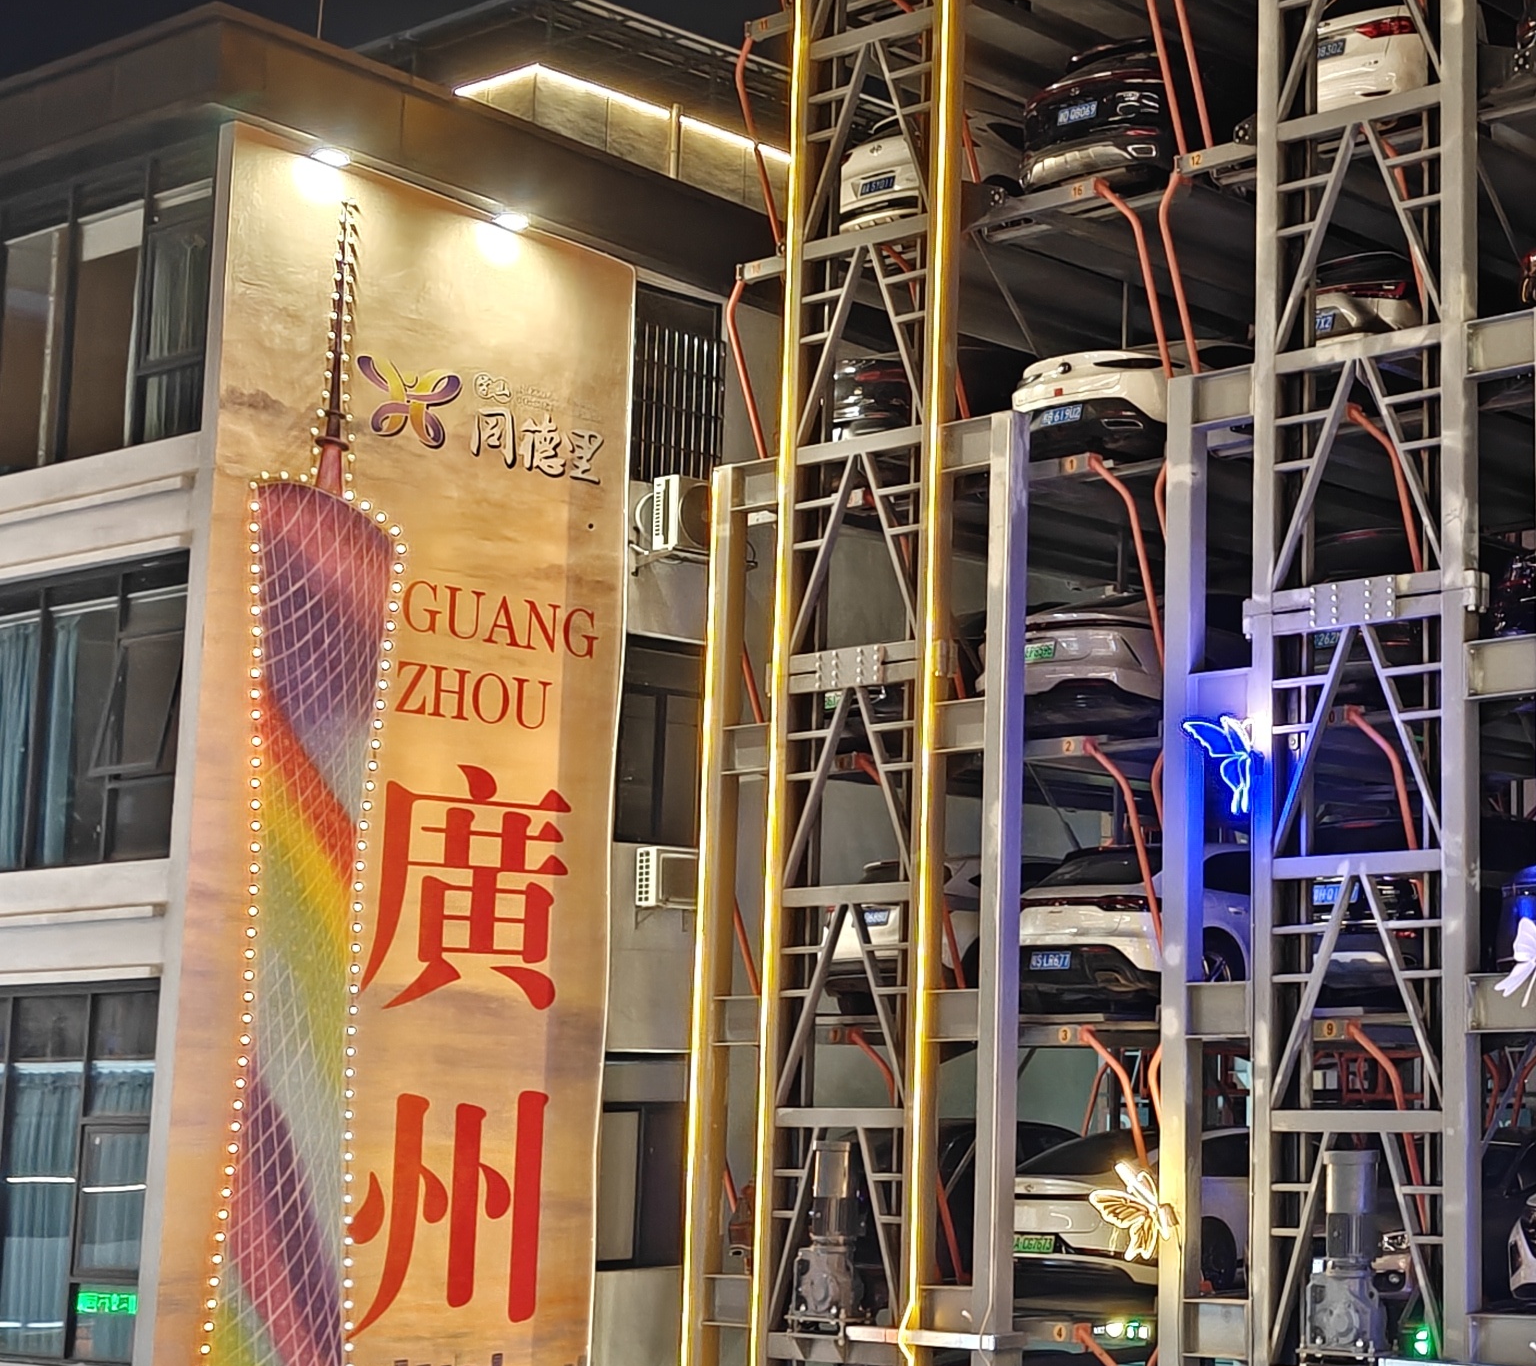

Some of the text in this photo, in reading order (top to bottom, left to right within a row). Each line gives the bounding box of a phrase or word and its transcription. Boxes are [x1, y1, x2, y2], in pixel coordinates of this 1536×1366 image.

[471, 407, 604, 485] 同德里
[402, 580, 598, 659] GUANG
[395, 662, 553, 729] ZHOU
[347, 764, 572, 1340] 廣州
